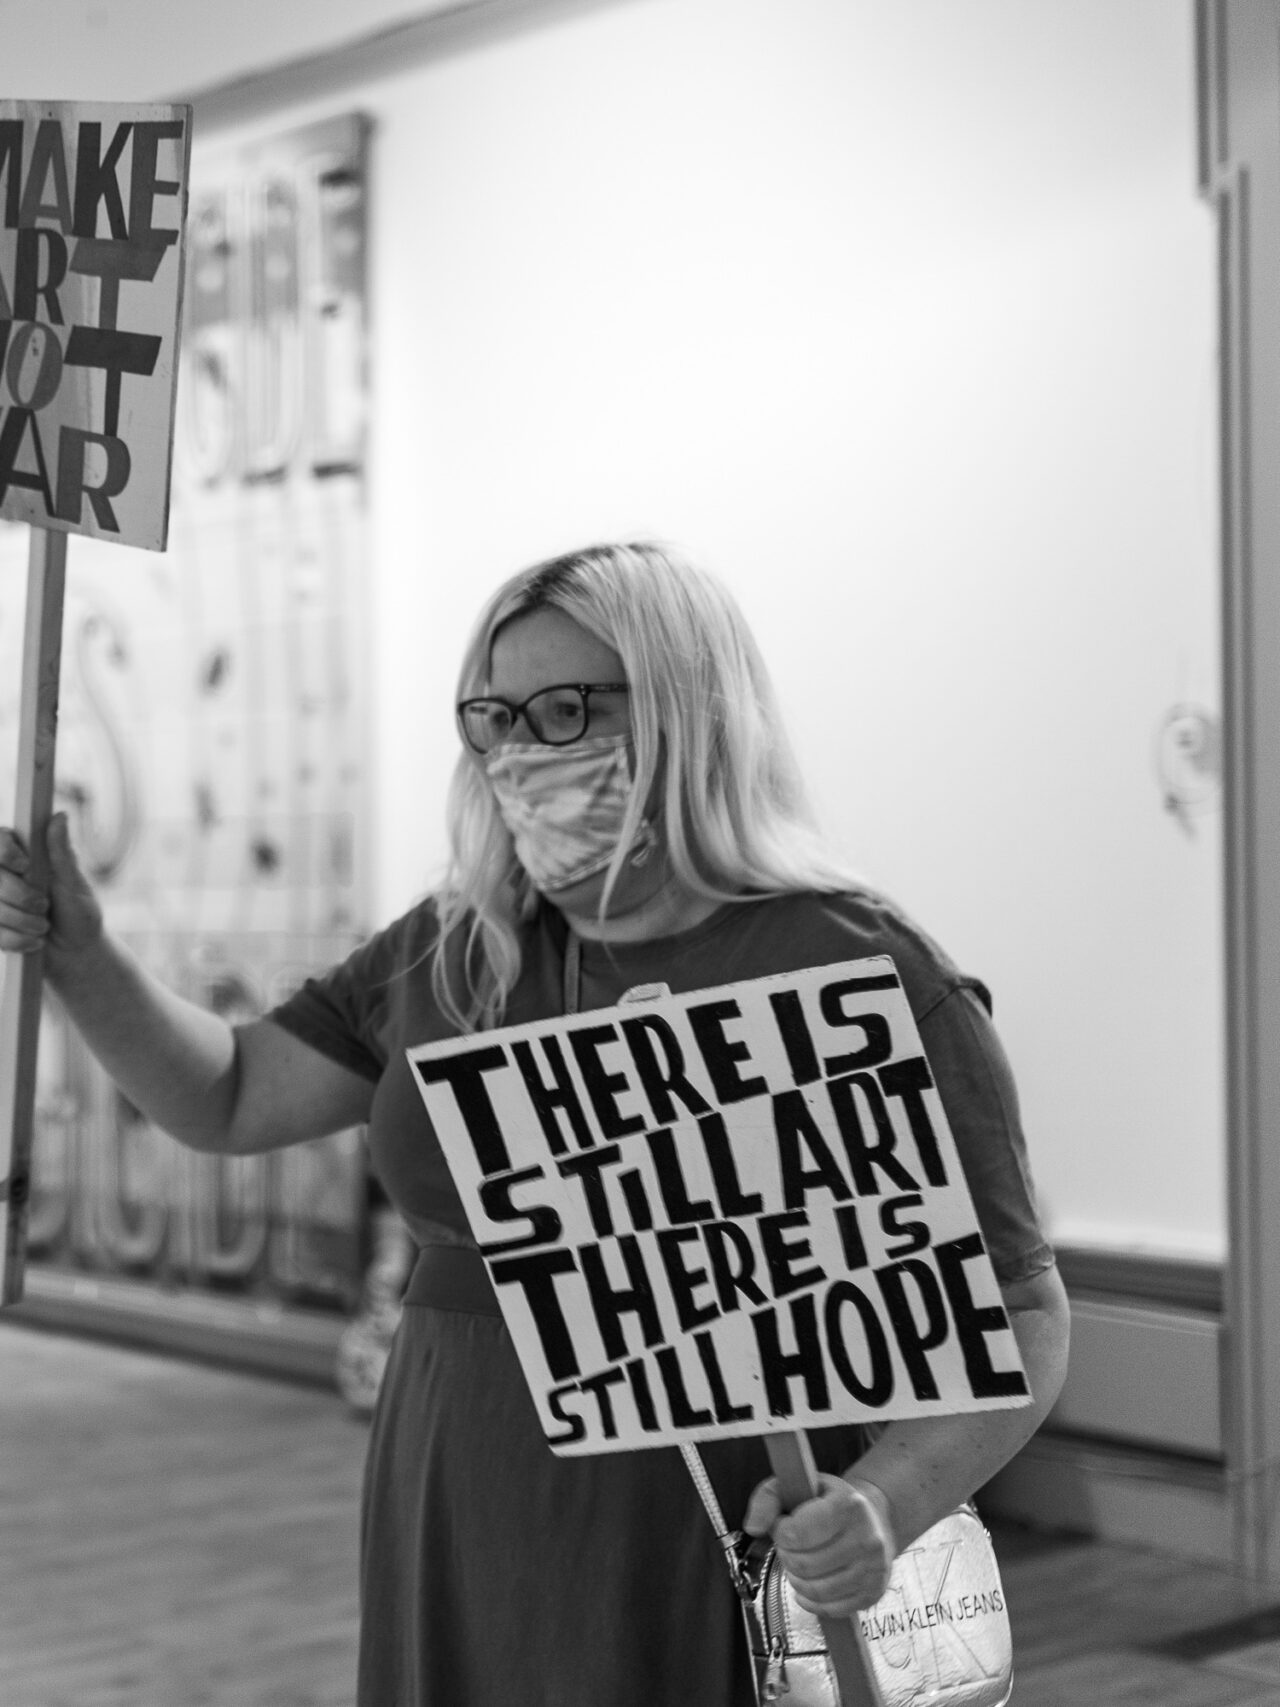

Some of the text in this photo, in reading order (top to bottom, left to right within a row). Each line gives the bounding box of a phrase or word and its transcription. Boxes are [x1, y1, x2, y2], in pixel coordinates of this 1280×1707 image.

[415, 998, 770, 1178] THERE
[770, 973, 900, 1087] IS
[477, 1112, 763, 1256] STILL
[771, 1056, 949, 1211] ART
[489, 1194, 932, 1382] THERE IS
[546, 1232, 1030, 1447] STILL HOPE
[905, 1600, 954, 1632] KLEIN
[955, 1589, 1004, 1621] JEANS
